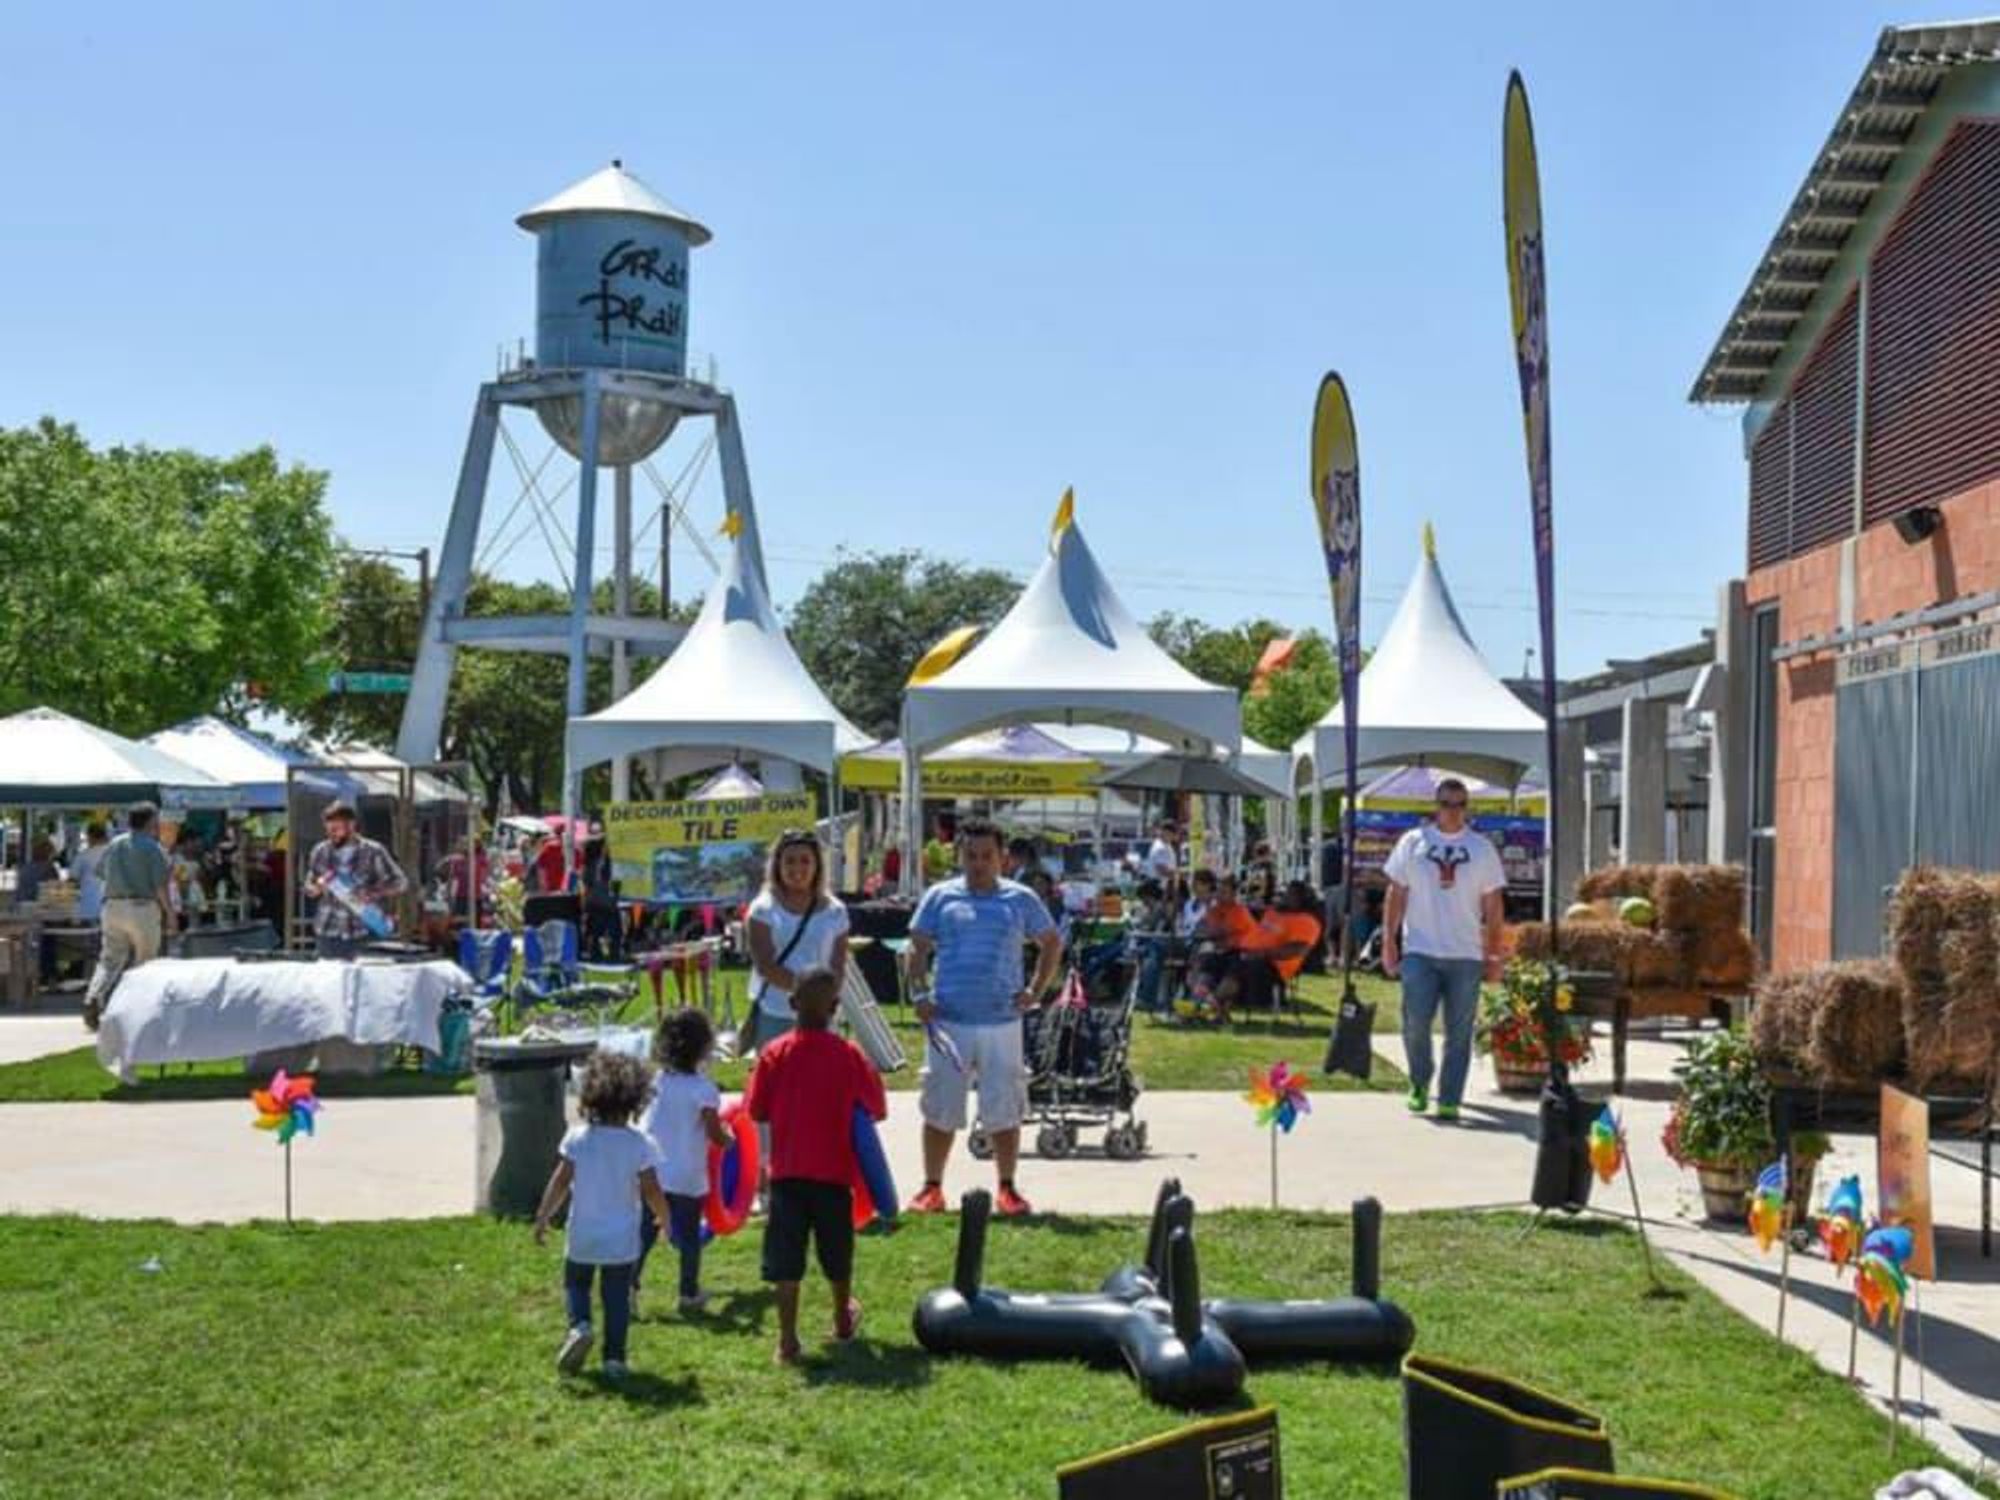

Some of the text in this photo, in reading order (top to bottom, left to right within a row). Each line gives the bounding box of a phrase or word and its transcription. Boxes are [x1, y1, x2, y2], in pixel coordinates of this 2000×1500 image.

[610, 797, 810, 821] DECORATE YOUR OWN
[682, 818, 738, 842] TILE
